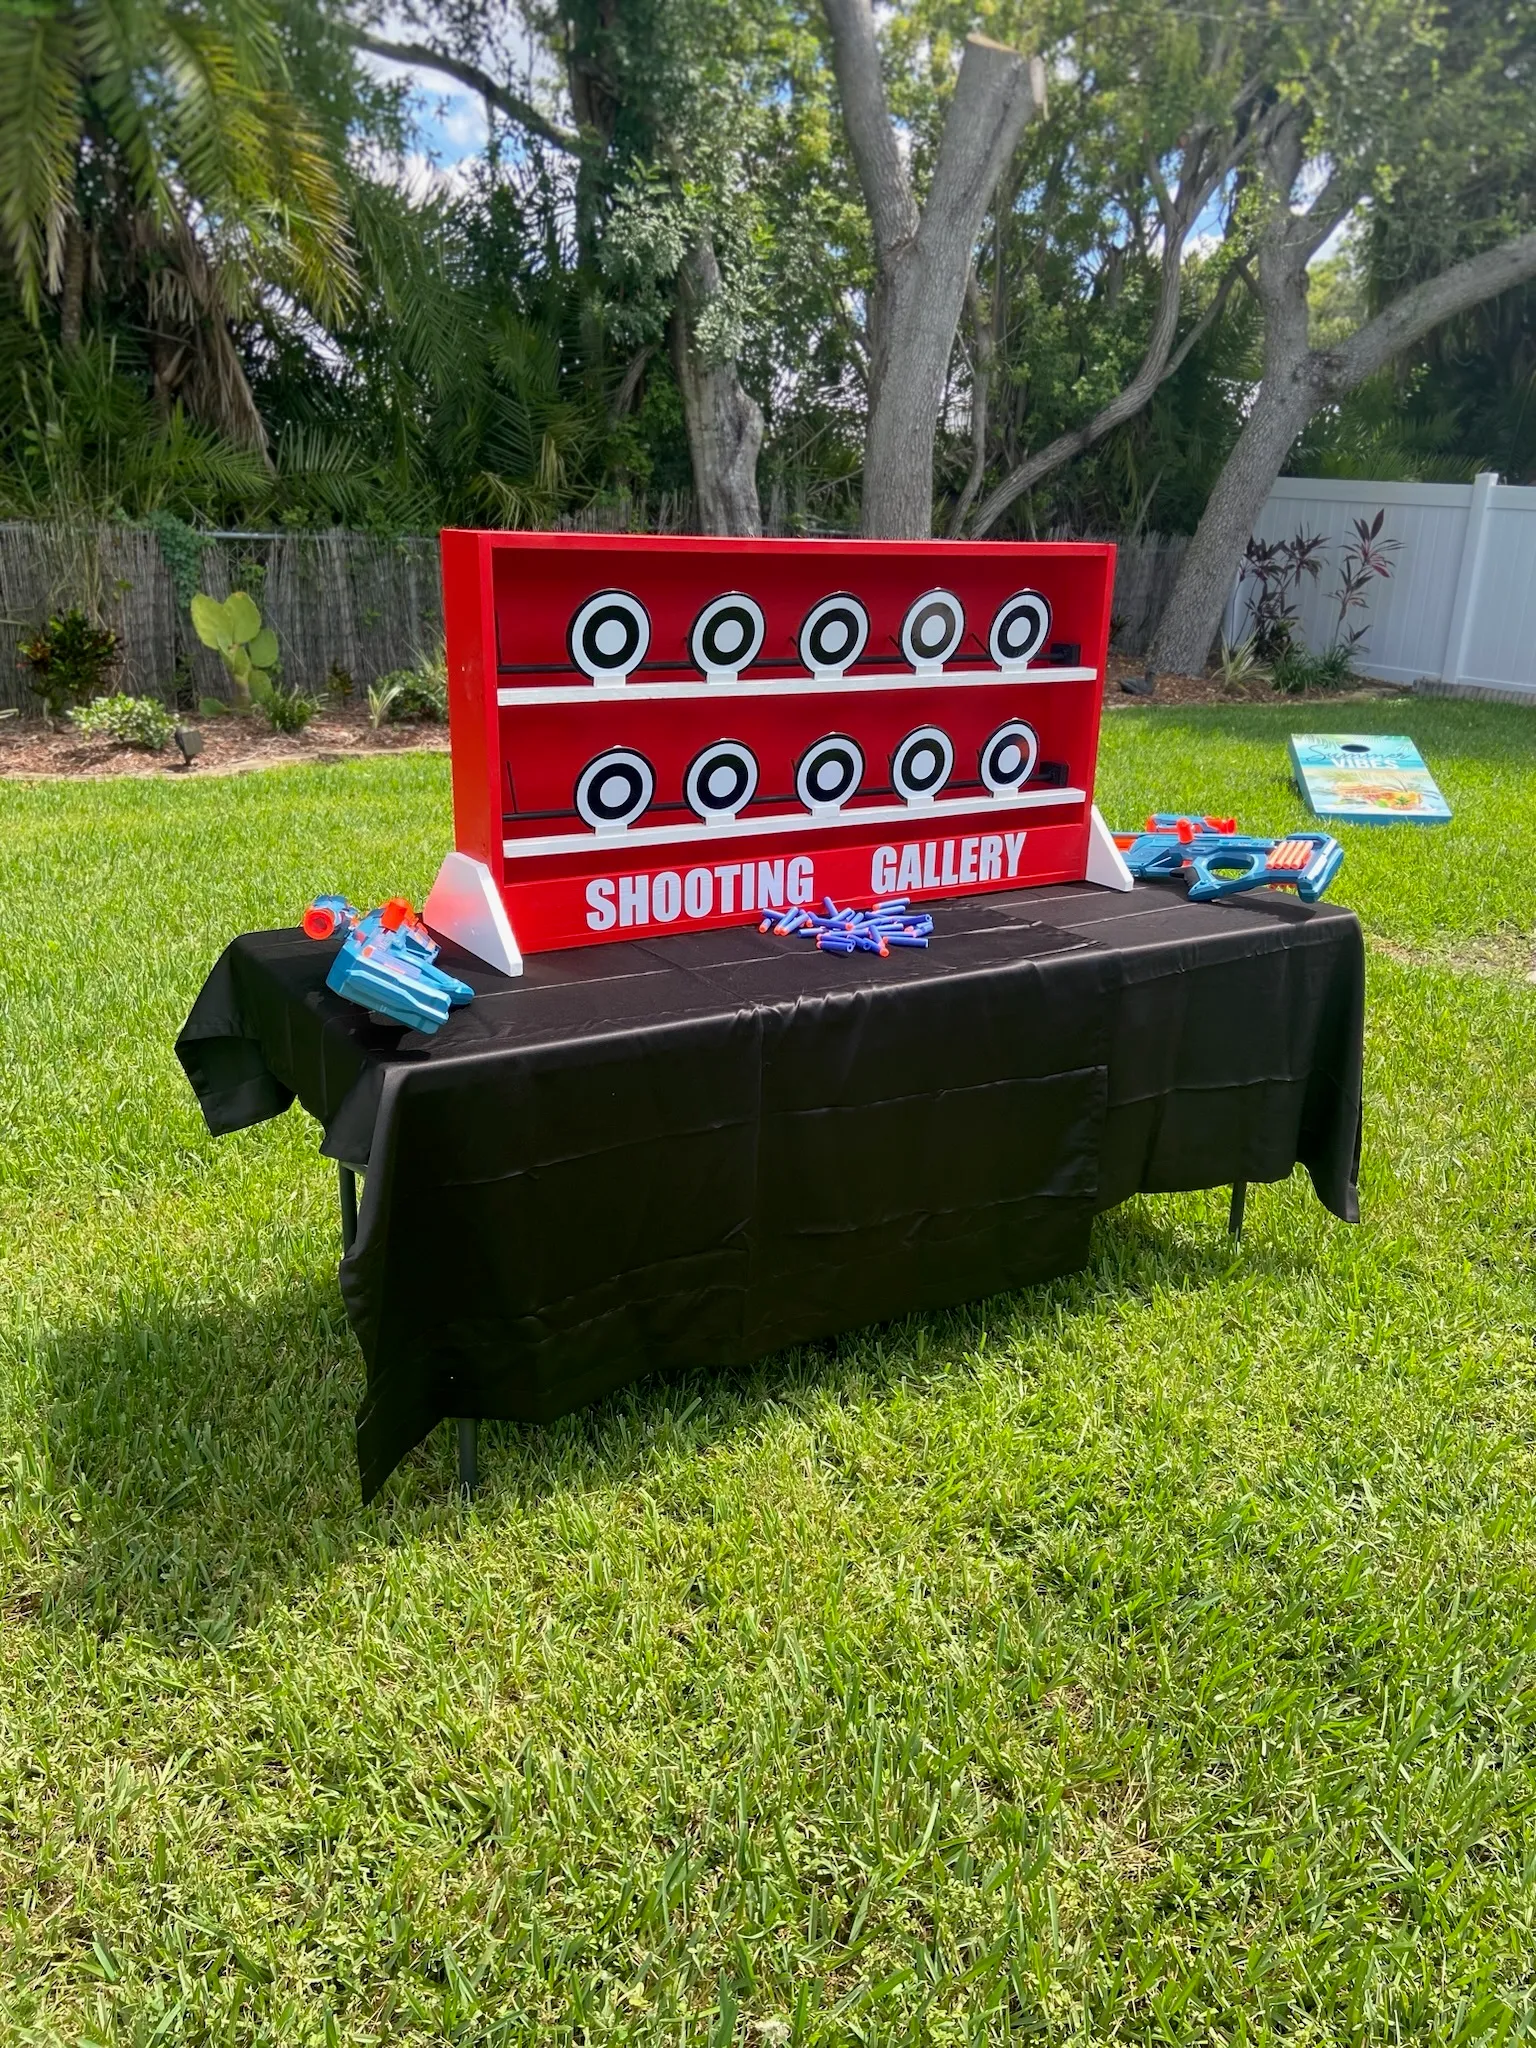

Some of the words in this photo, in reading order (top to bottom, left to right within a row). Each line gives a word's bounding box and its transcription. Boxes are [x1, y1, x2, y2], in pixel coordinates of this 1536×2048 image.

[1307, 745, 1411, 762] Summer
[1331, 758, 1399, 769] VIBES
[585, 856, 815, 931] SHOOTING
[871, 832, 1028, 895] GALLERY
